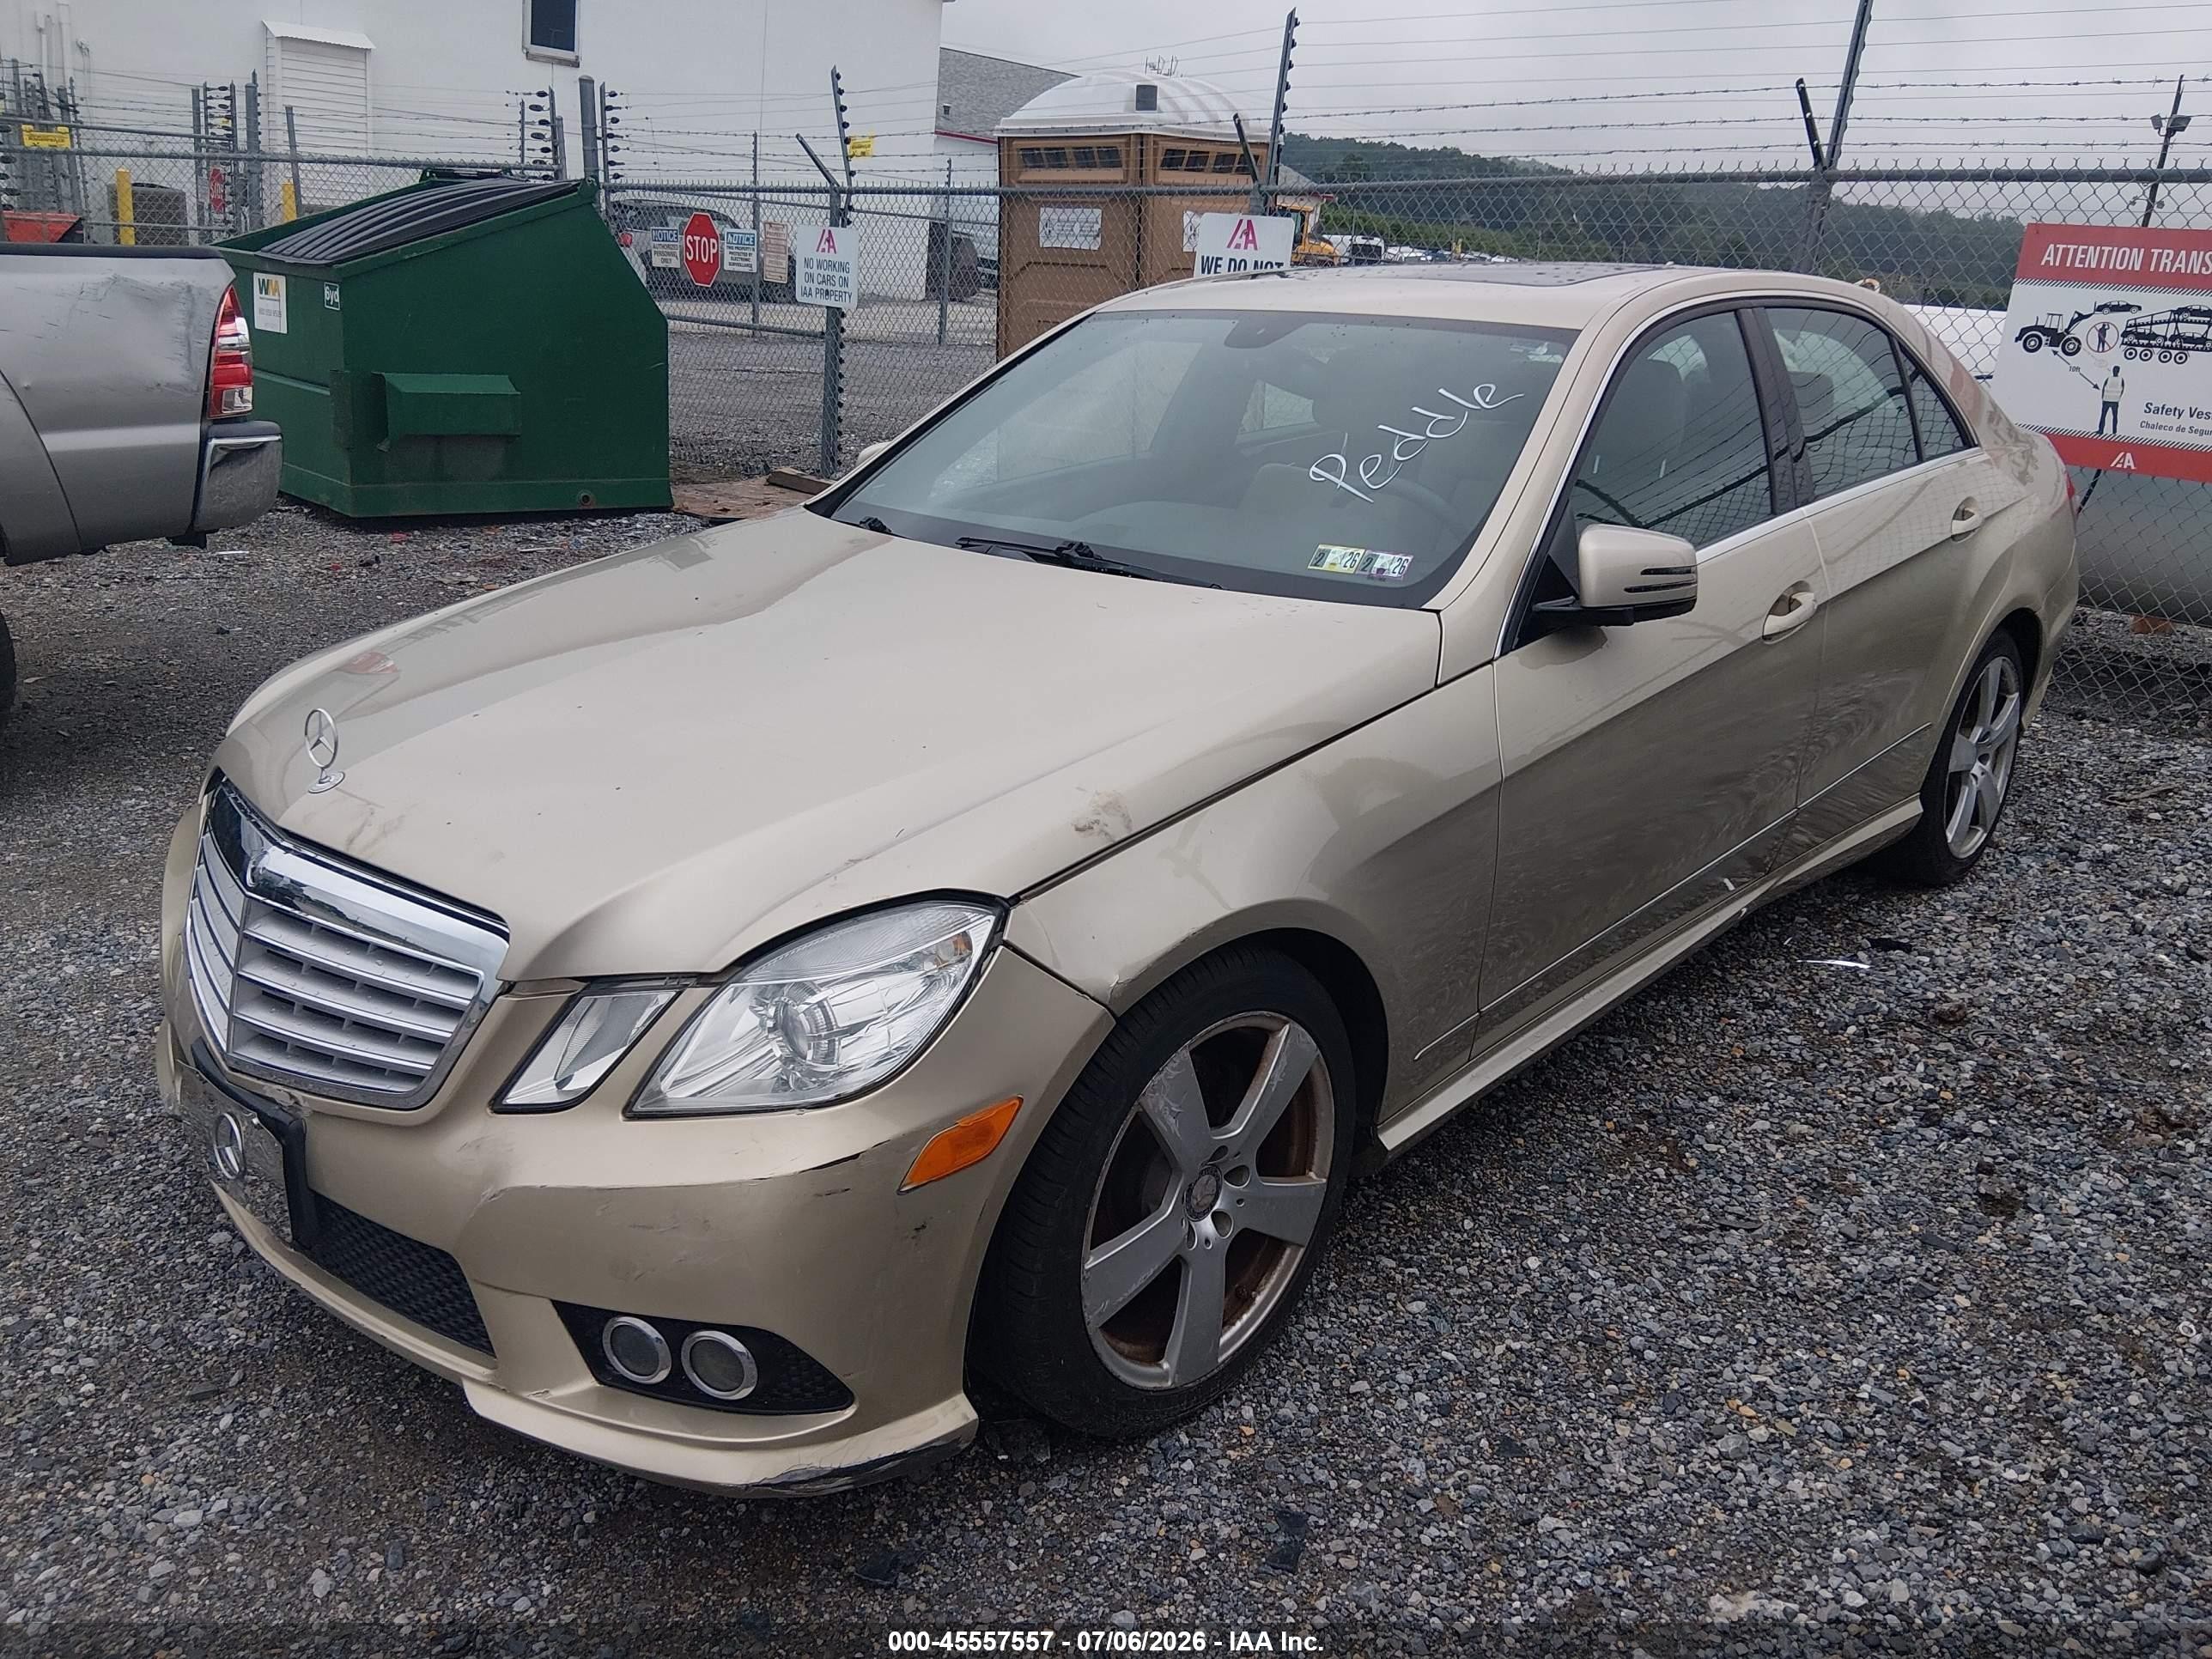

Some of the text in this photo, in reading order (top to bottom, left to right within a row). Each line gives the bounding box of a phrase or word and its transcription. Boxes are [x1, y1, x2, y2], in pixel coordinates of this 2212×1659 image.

[653, 229, 678, 241] NOTICE
[727, 233, 755, 245] NOTICE
[686, 234, 718, 264] STOP
[2040, 243, 2145, 271] ATTENTION
[804, 257, 850, 274] NO WORKING
[1201, 255, 1224, 275] WE
[1227, 257, 1248, 273] DO
[804, 271, 849, 289] ON CARS ON
[325, 285, 339, 305] 6yd
[800, 285, 853, 303] IAA PROPERTY
[2143, 402, 2212, 420] Safety Ves
[2140, 420, 2173, 431] Chaleco
[2175, 424, 2186, 433] de
[1310, 383, 1525, 503] Peddle
[1314, 551, 1360, 568] 2 26
[1361, 556, 1409, 574] 2 26
